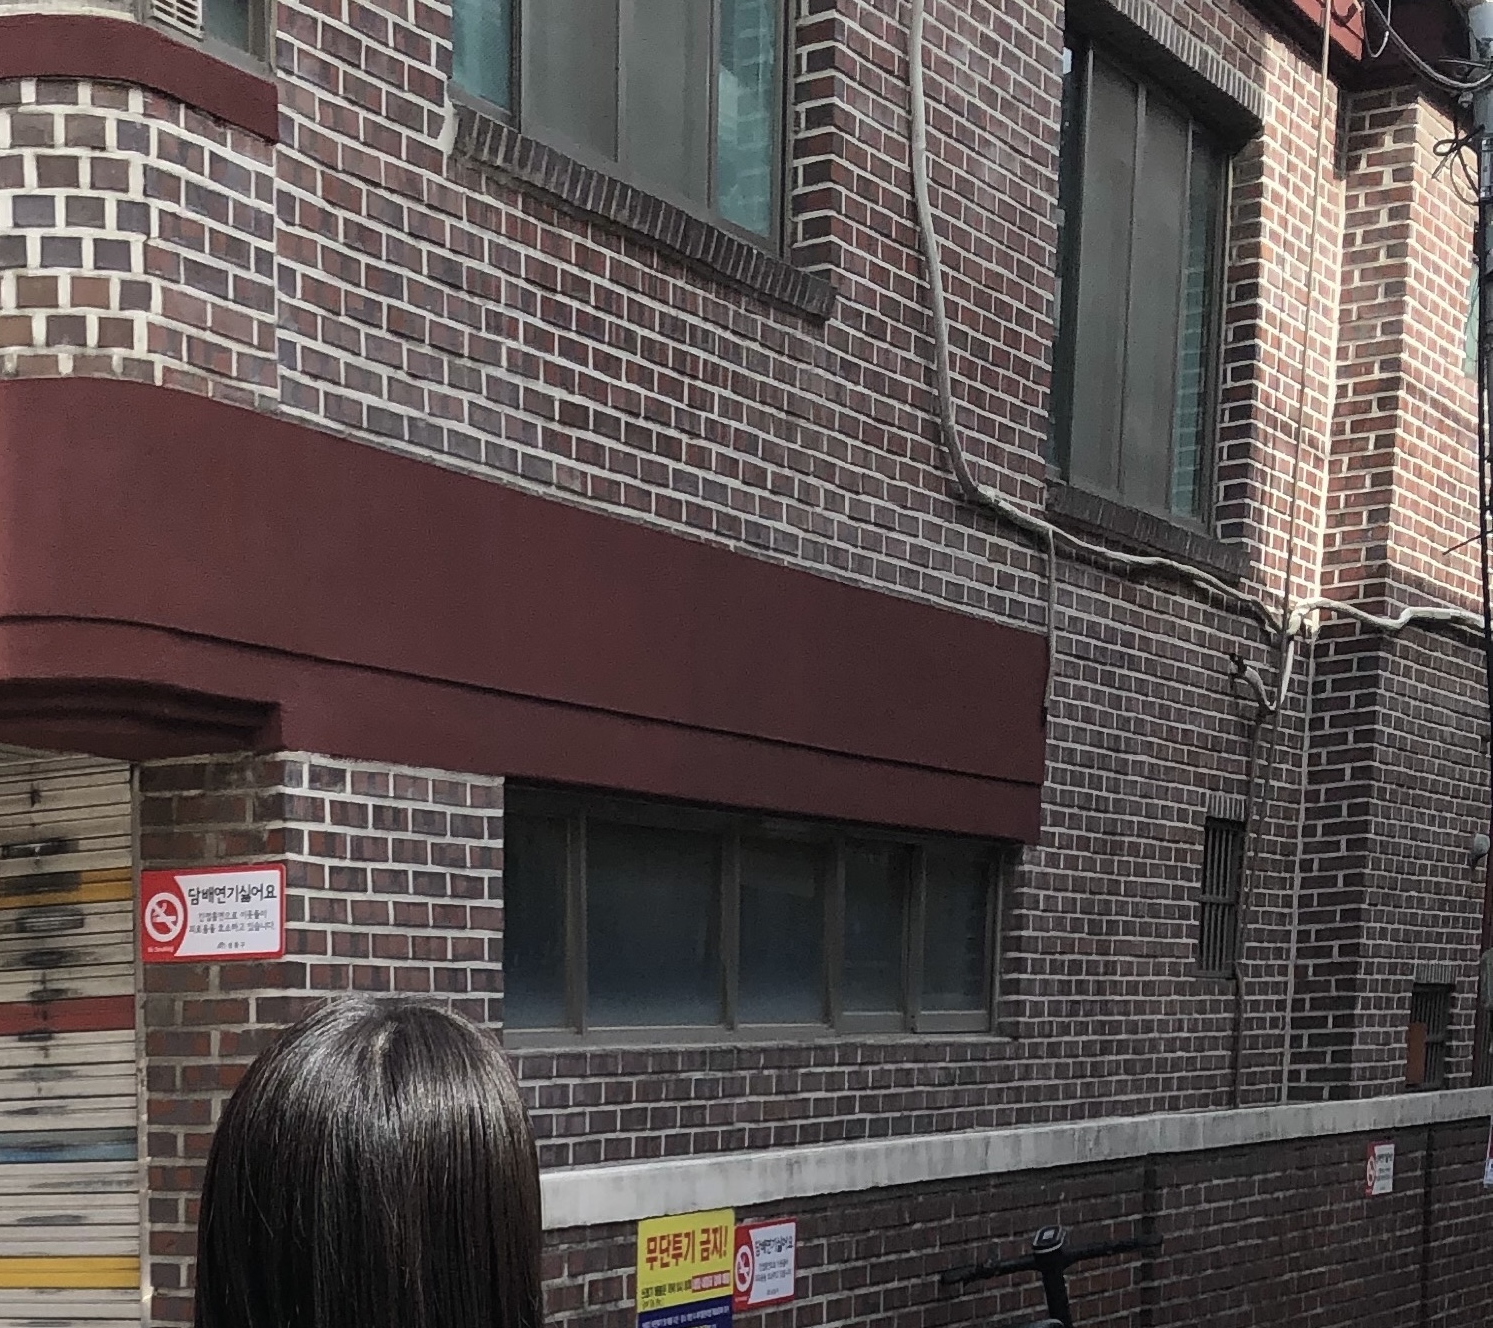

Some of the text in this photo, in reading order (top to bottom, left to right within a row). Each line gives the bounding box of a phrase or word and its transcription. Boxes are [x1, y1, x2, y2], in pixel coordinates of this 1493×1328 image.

[188, 883, 278, 906] 담배연기싫어요
[645, 1224, 729, 1271] 무단투기 금지!
